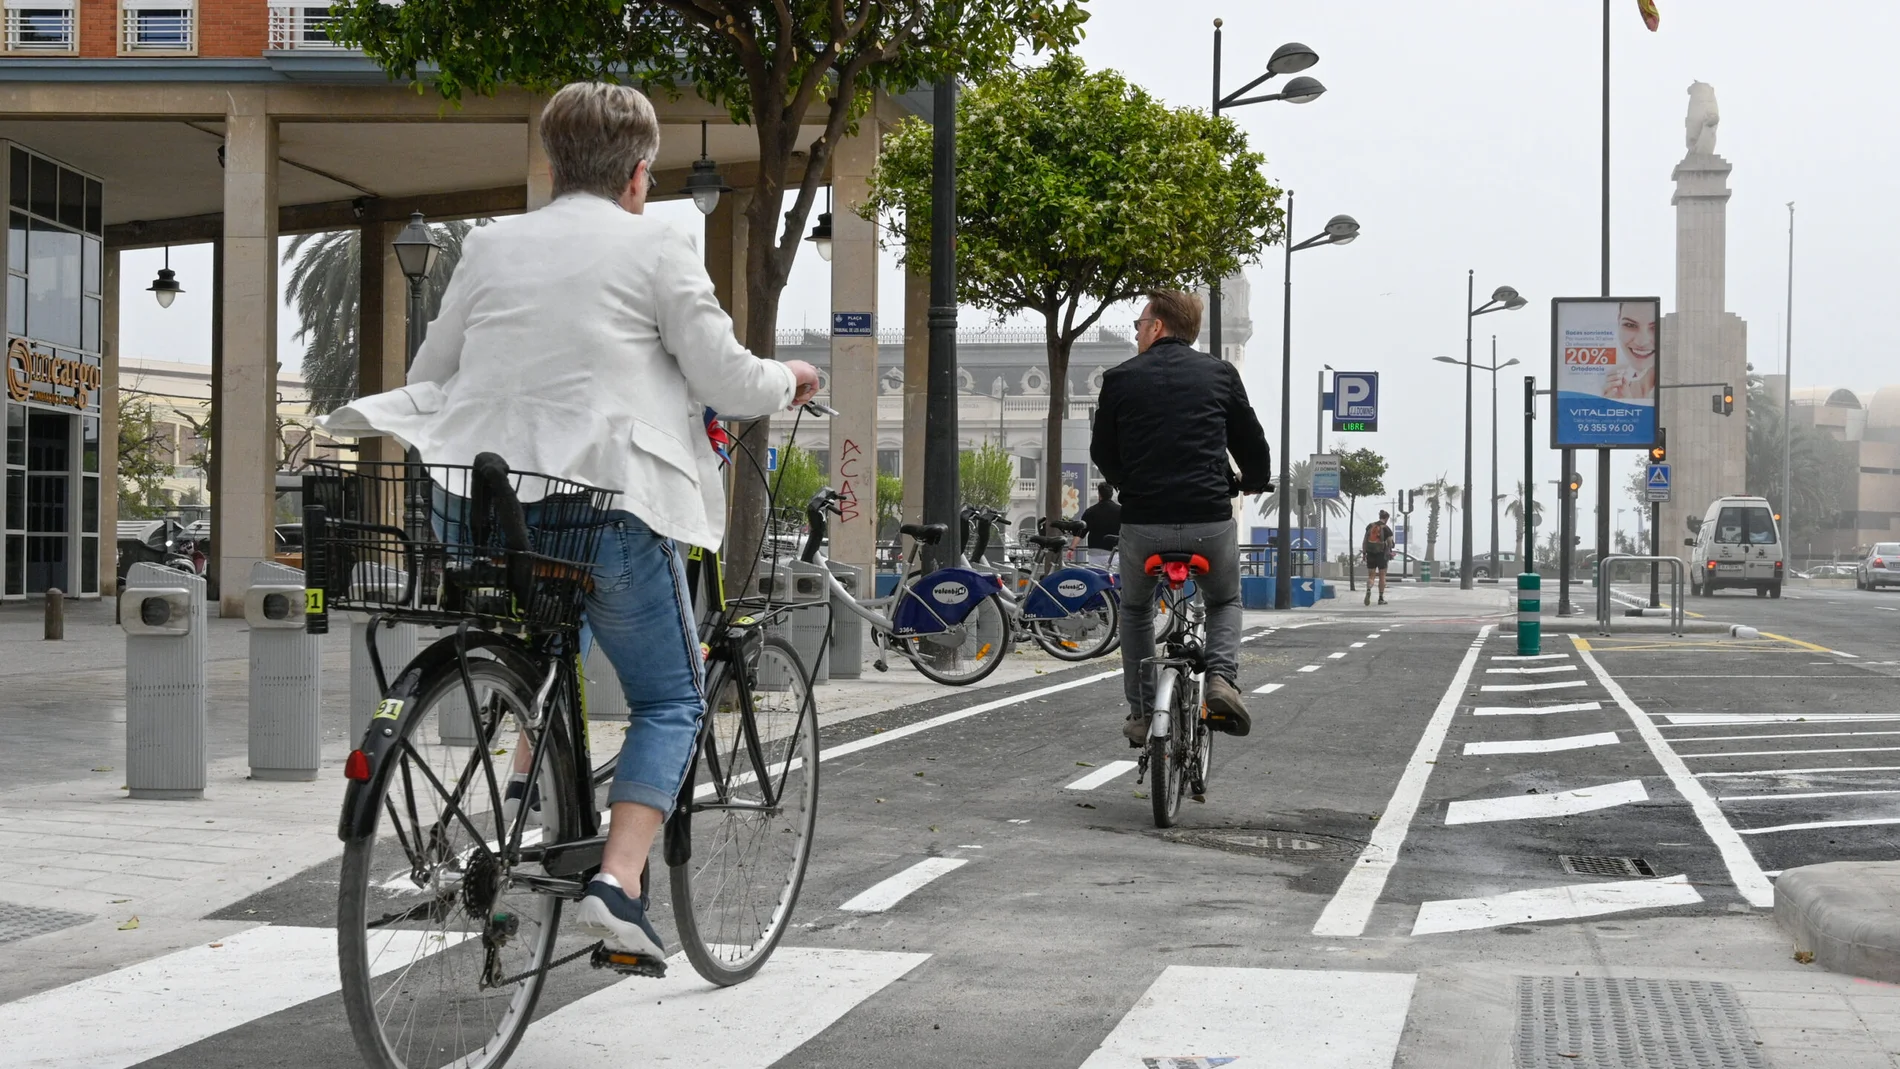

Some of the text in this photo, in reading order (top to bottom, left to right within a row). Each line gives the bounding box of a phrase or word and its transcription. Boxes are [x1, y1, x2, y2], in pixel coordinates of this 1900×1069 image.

[1566, 348, 1609, 365] 20%
[1338, 377, 1370, 416] P
[1570, 408, 1642, 417] VITALDENT
[1342, 423, 1365, 431] LIBRE
[1578, 424, 1634, 432] 96 355 96 00
[1061, 470, 1079, 479] alles
[376, 701, 398, 716] 91
